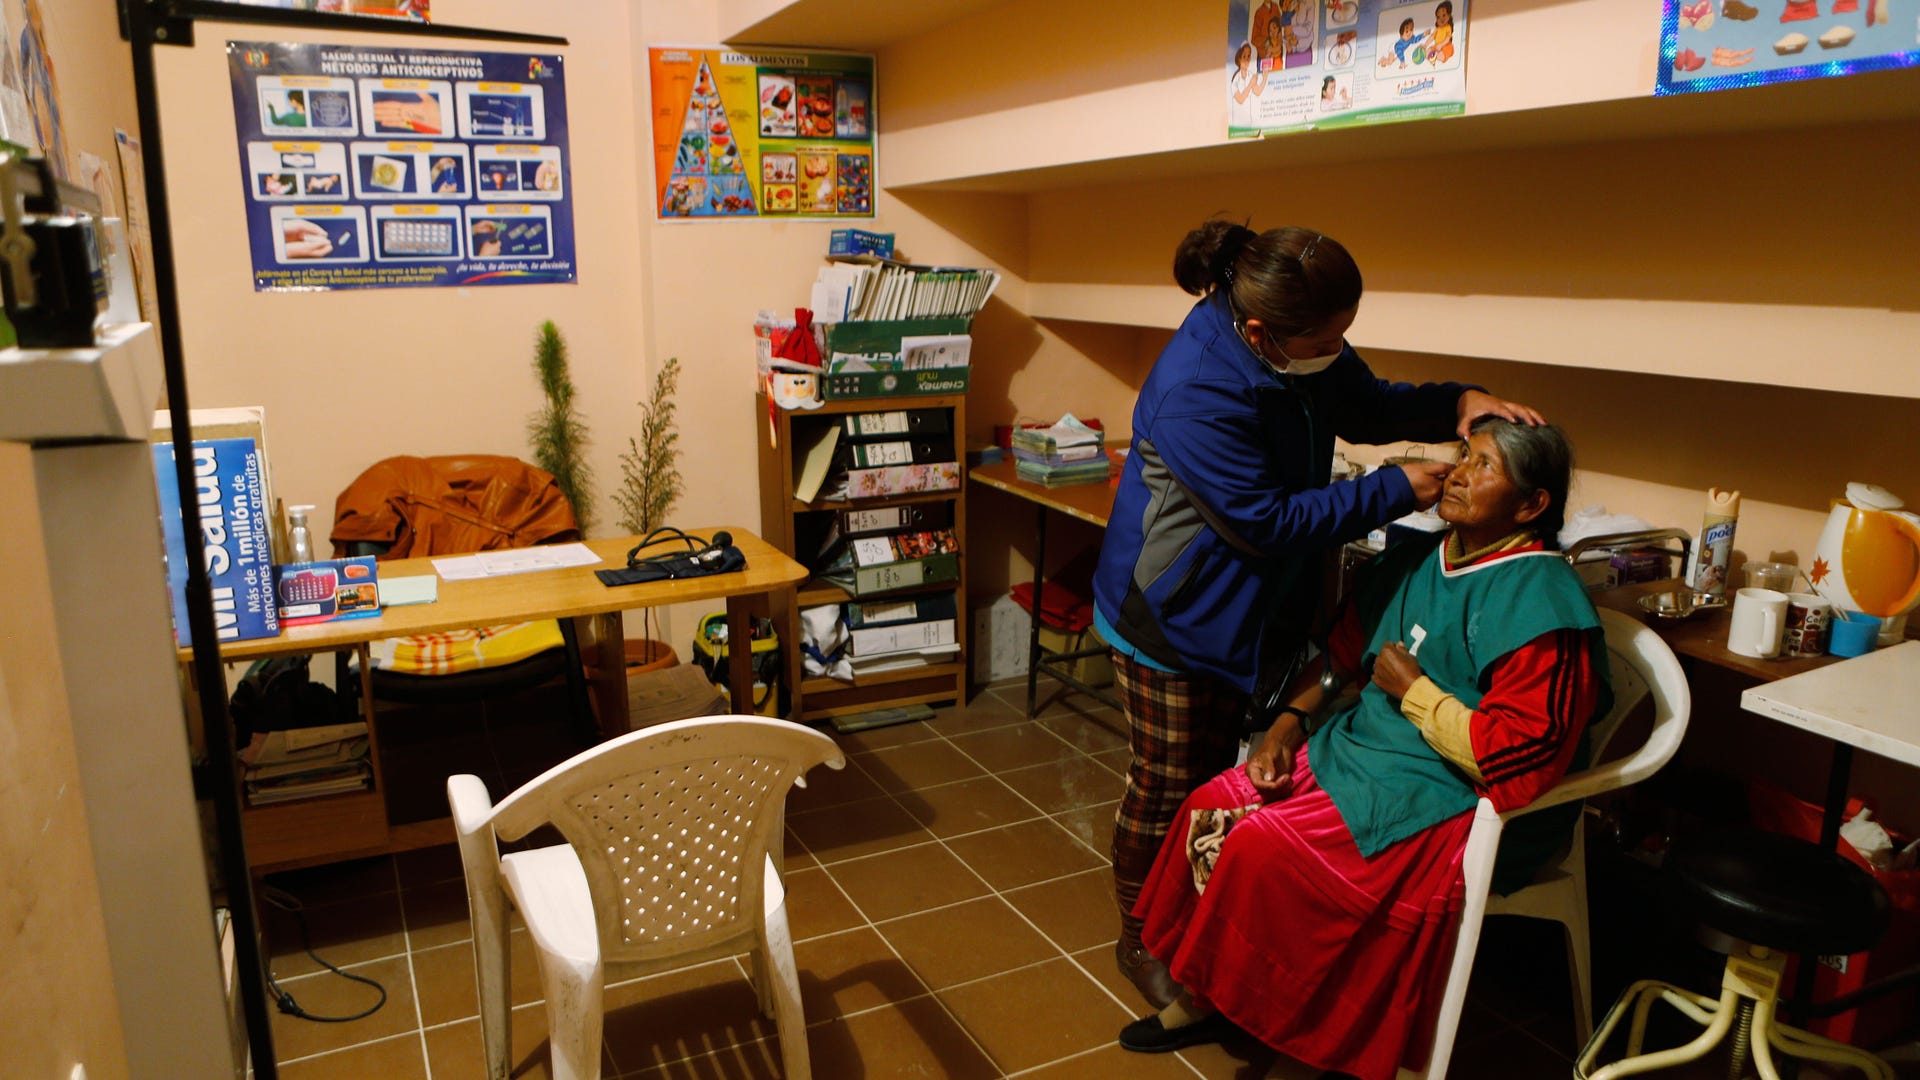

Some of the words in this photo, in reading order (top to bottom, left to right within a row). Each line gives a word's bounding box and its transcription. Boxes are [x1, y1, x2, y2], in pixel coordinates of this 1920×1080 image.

[321, 51, 355, 62] SALUD
[358, 53, 396, 63] SEXUAL
[399, 55, 406, 63] Y
[408, 55, 483, 67] REPRODUCTIVA
[725, 53, 746, 63] LOS
[750, 54, 806, 65] ALIMENTOS
[321, 61, 378, 74] MÉTODOS
[381, 65, 484, 78] ANTICONCEPTIVOS
[231, 474, 245, 491] de
[172, 447, 231, 577] Salud
[250, 511, 269, 563] médicas
[243, 568, 257, 585] de
[246, 587, 261, 612] Más
[257, 565, 277, 631] atenciones
